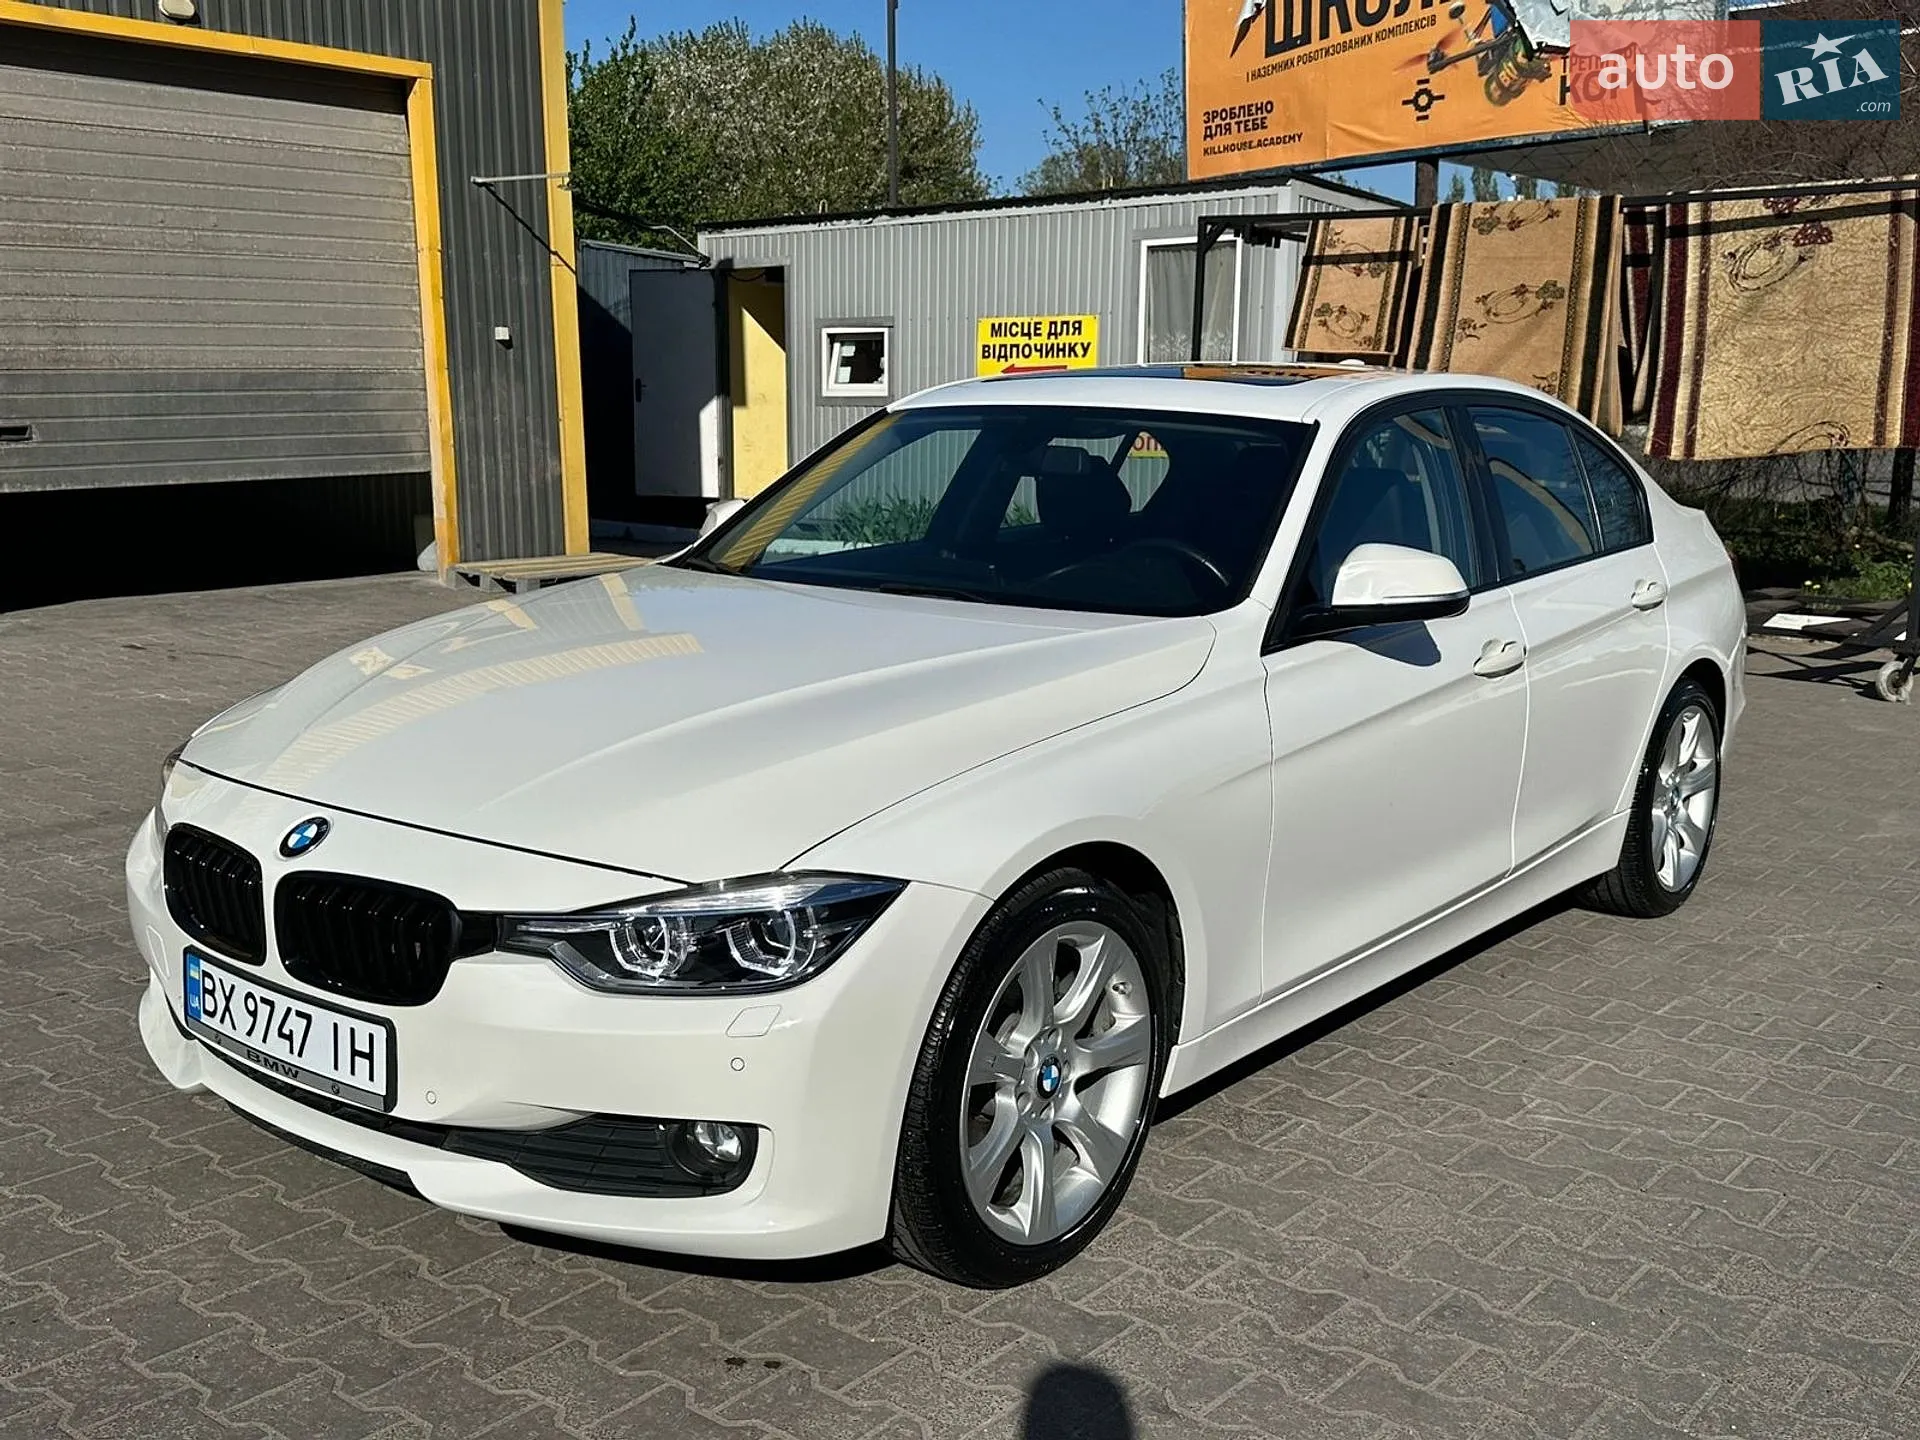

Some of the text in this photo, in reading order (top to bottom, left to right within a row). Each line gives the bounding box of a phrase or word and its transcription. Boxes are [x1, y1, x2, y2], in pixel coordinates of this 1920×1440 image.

[1250, 59, 1296, 81] НАЗЕМНИХ
[1296, 33, 1373, 66] РОБОТИЗОВАНИХ
[1374, 14, 1437, 43] КОМПЛЕКСІВ
[1203, 100, 1274, 124] ЗРОБЛЕНО
[1203, 116, 1268, 141] ДЛЯ ТЕБЕ
[1203, 132, 1303, 157] KILLHOUSE.ACADEMY
[990, 320, 1083, 340] МІСЦЕ ДЛЯ
[981, 342, 1092, 363] ВІДПОЧИНКУ
[201, 969, 375, 1083] BX 9747 IH
[247, 1050, 300, 1079] BMW
